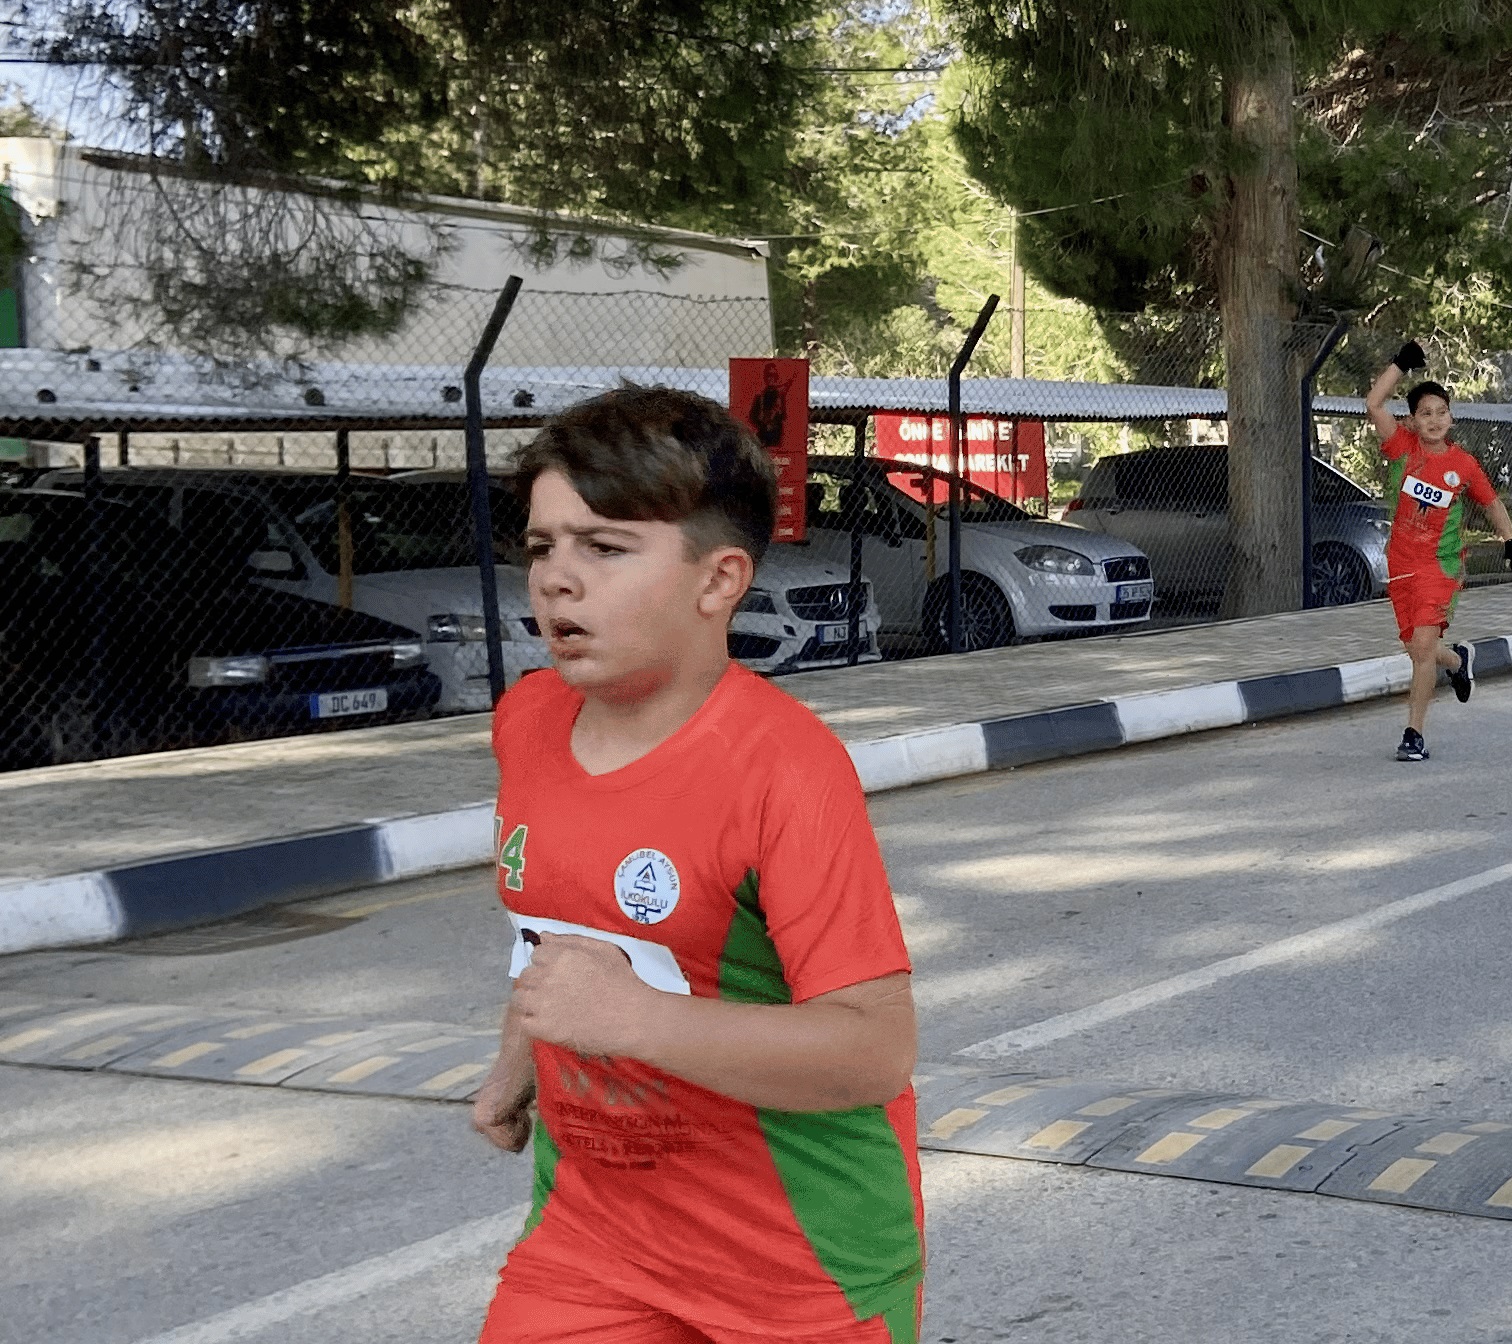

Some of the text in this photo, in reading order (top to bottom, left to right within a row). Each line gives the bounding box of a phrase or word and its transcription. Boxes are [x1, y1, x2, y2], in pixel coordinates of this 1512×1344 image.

[1413, 482, 1443, 503] 089
[332, 693, 376, 713] DC 649
[493, 816, 528, 892] 4
